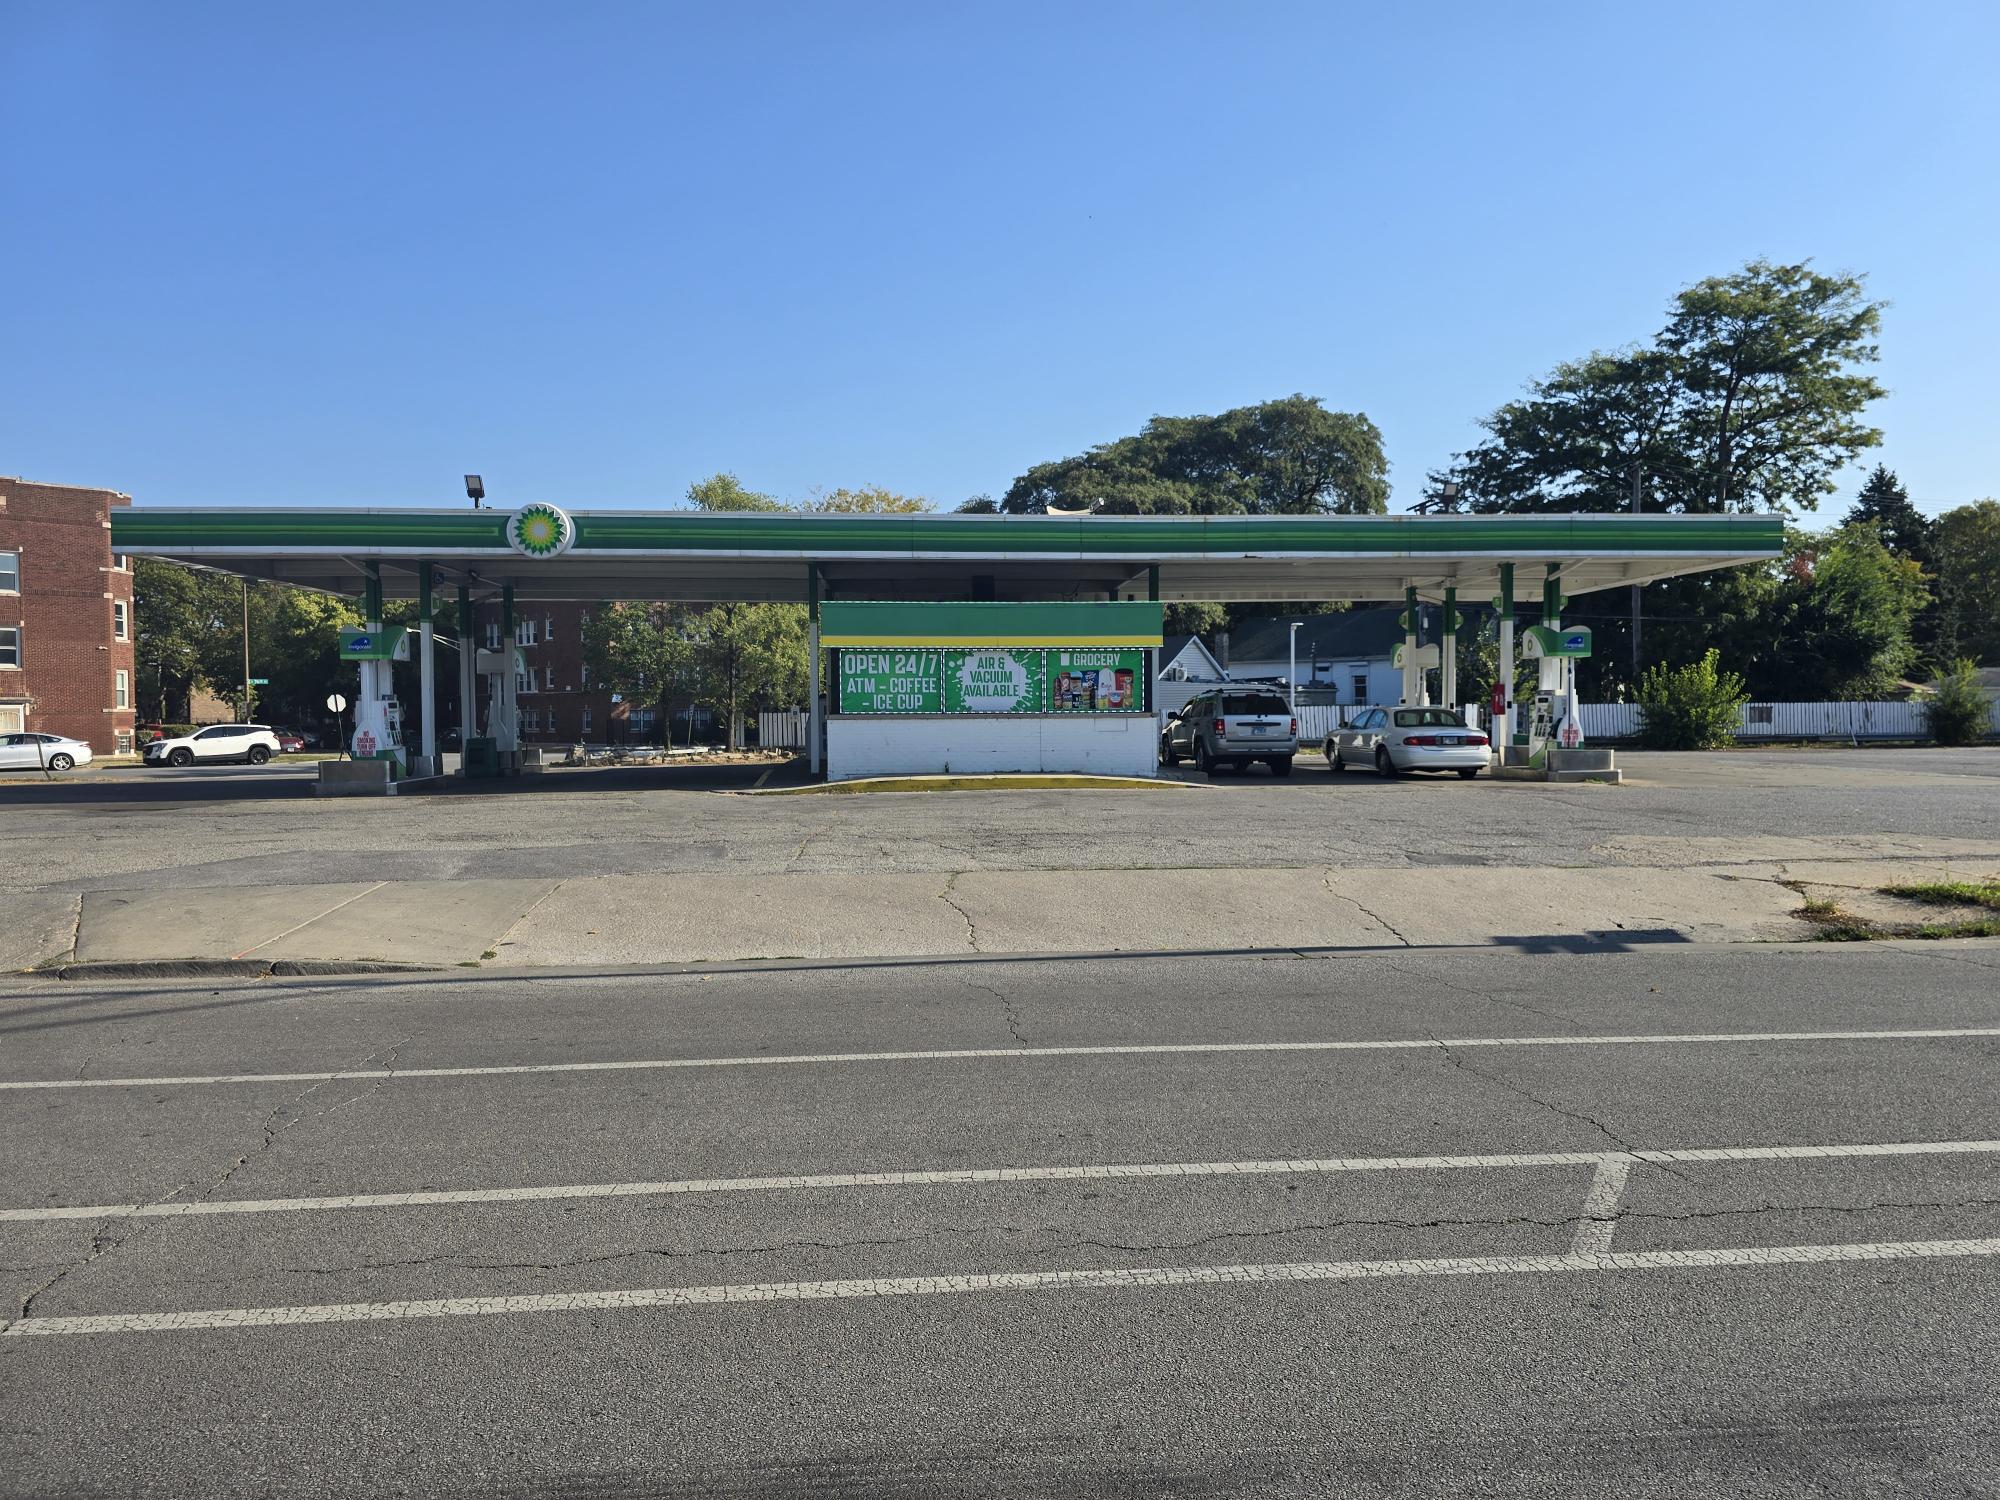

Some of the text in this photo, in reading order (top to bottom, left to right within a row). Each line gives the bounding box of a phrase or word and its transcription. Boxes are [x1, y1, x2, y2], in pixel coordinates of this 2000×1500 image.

[844, 652, 938, 677] OPEN 24/7
[977, 656, 1005, 670] AIR &
[1073, 653, 1121, 666] GROCERY
[969, 670, 1013, 683] VACUUM
[846, 677, 876, 693] ATM
[889, 677, 937, 693] COFFEE
[963, 684, 1020, 697] AVAILABLE
[873, 694, 894, 710] ICE
[897, 694, 923, 710] CUP
